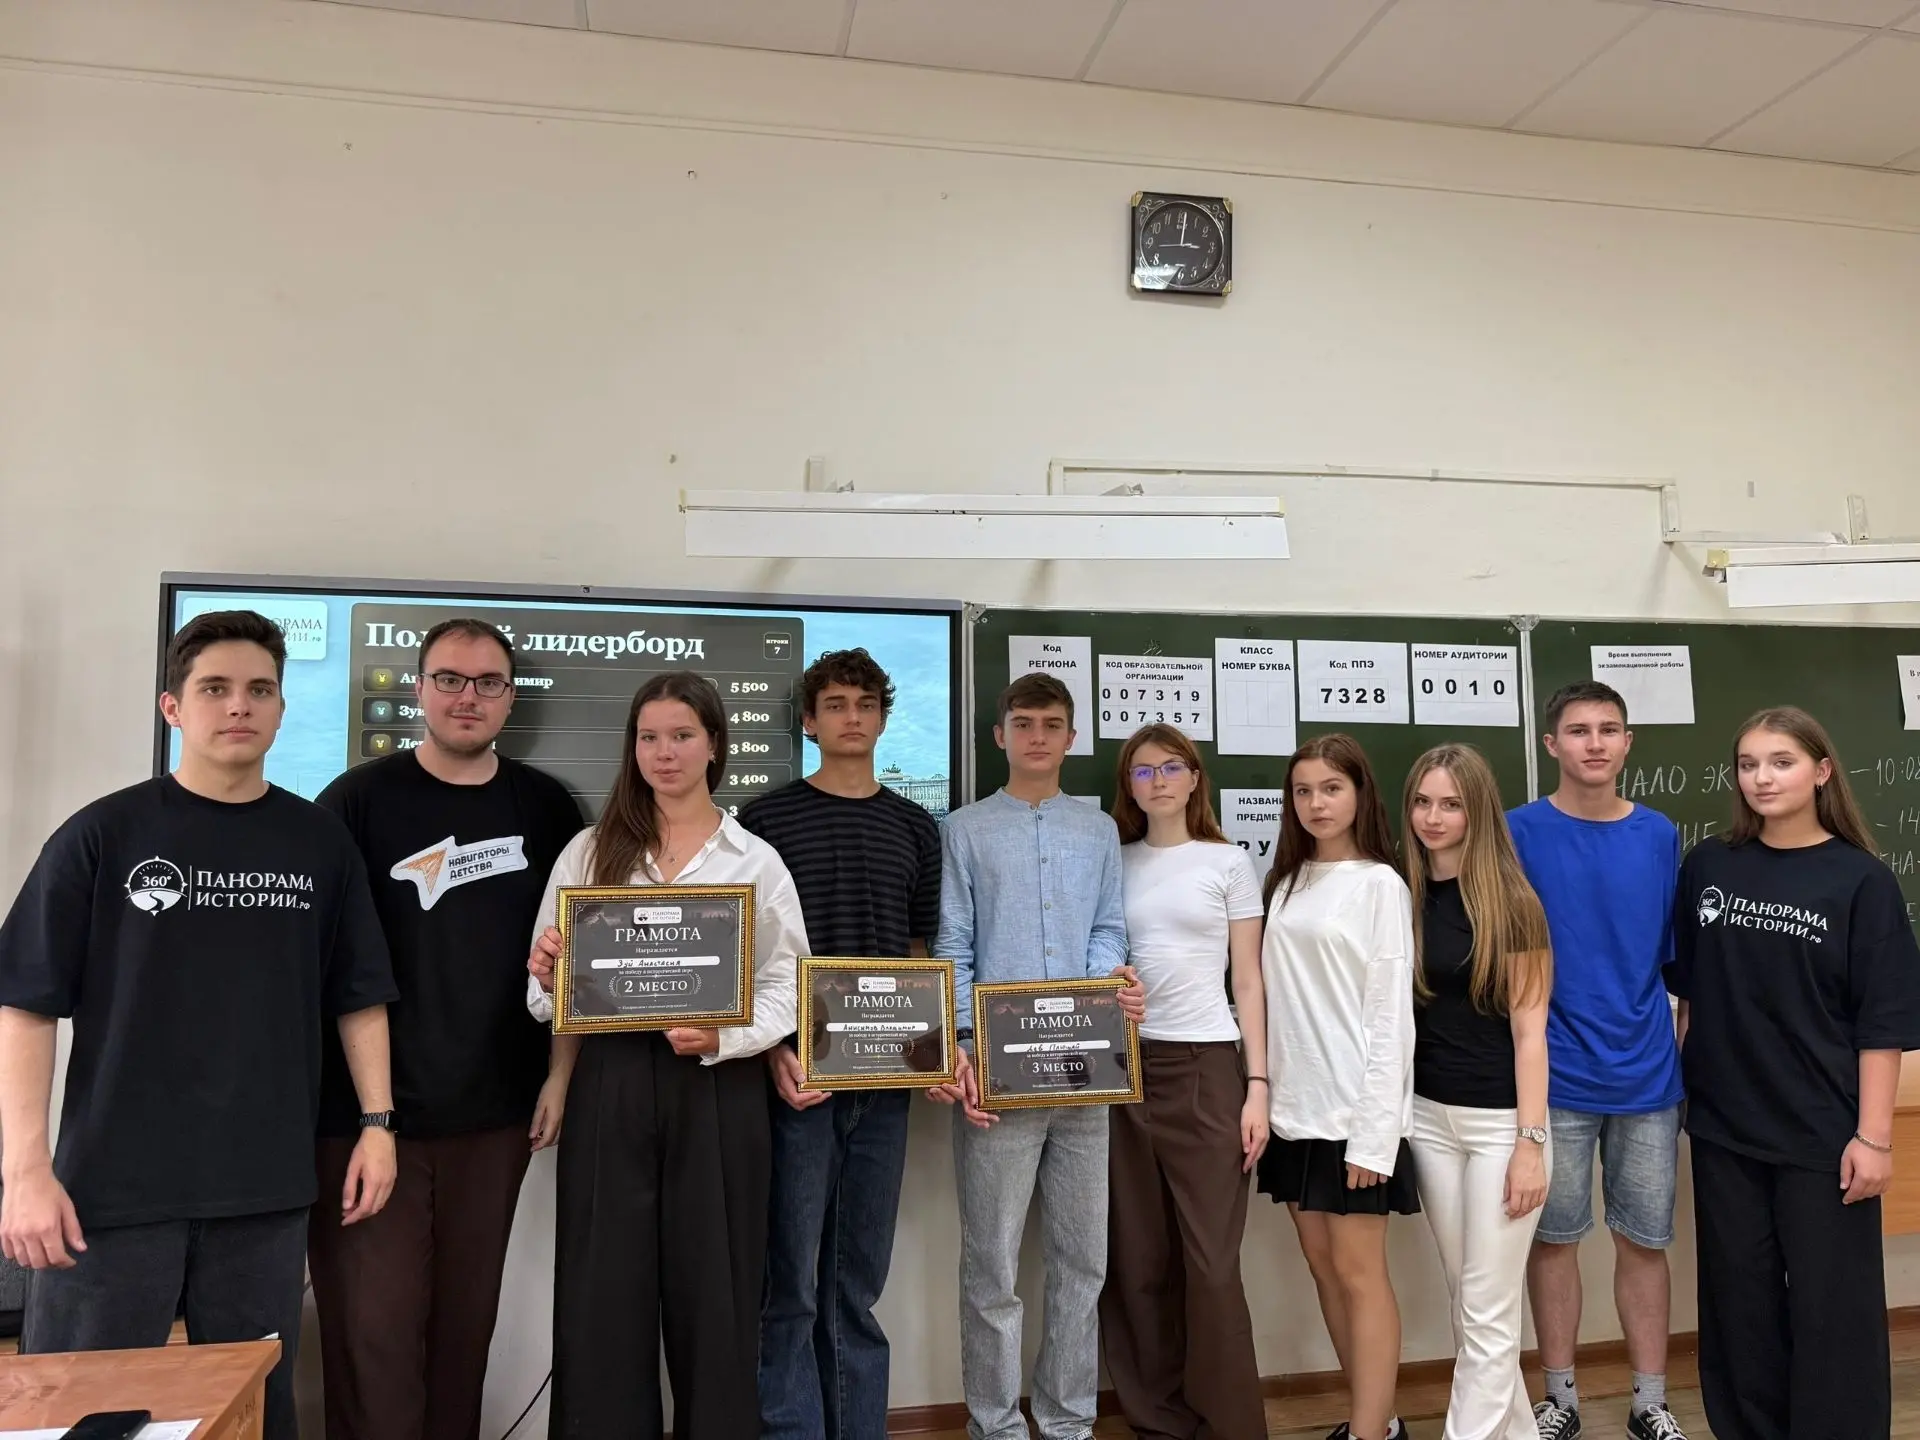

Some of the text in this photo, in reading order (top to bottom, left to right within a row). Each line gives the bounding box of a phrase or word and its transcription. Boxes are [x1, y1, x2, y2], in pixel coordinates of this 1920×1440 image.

[1152, 222, 1161, 234] 10
[1202, 226, 1209, 238] 2
[1147, 237, 1154, 248] 9
[1208, 242, 1215, 253] 3
[1153, 254, 1159, 265] 8
[1203, 258, 1208, 269] 4
[1178, 269, 1184, 280] 6
[522, 630, 704, 661] лидерборд
[774, 647, 781, 655] 7
[1043, 644, 1062, 653] Код
[1240, 646, 1273, 655] КЛАСС
[1414, 651, 1508, 660] НОМЕР АУДИТОРИИ
[1029, 660, 1077, 669] РЕГИОНА
[1105, 661, 1203, 671] КОД ОБРАЗОВАТЕЛЬНОЙ
[1222, 662, 1291, 671] НОМЕР БУКВА
[1329, 660, 1375, 670] Код ППЭ
[1660, 661, 1684, 669] работы
[1125, 673, 1184, 682] ОРГАНИЗАЦИИ
[449, 846, 510, 868] НАВИГАТОРЫ
[450, 861, 493, 880] ДЕТСТВА
[197, 871, 314, 892] ПАНОРАМА
[1733, 898, 1828, 931] ПАНОРАМА
[615, 927, 702, 942] ГРАМОТА
[624, 980, 688, 993] 2 МЕСТО
[844, 995, 913, 1008] ГРАМОТА
[1020, 1015, 1093, 1030] ГРАМОТА
[854, 1042, 903, 1054] 1 МЕСТО
[1032, 1062, 1084, 1073] 3 МЕСТО
